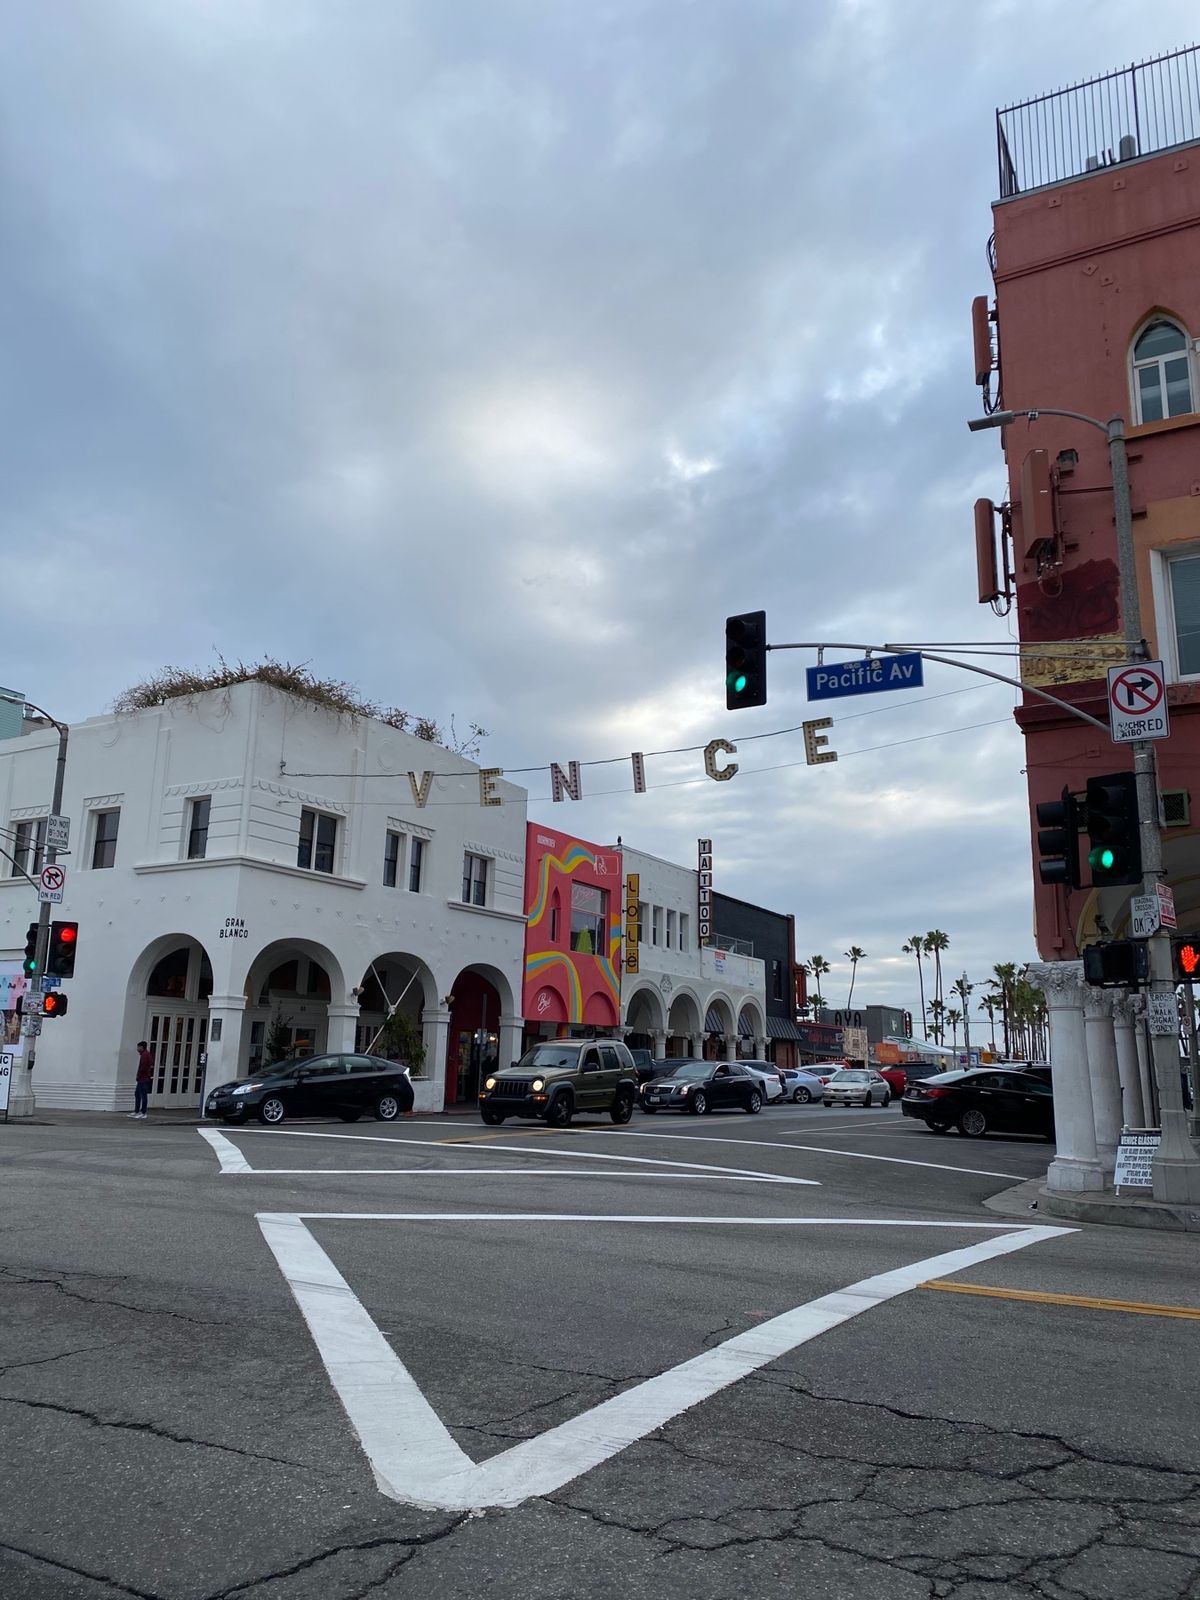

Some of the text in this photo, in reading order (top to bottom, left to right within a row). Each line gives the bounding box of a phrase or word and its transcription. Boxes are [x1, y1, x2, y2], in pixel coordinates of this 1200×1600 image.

[816, 663, 913, 690] Pacific Av
[1139, 718, 1163, 732] RED
[407, 716, 839, 809] VENICE
[49, 818, 69, 829] DO NOT
[700, 841, 709, 935] TATTOO
[40, 890, 61, 900] ON RED
[225, 917, 245, 928] GRAN
[1133, 917, 1145, 933] OK
[219, 928, 249, 939] BLANCO
[1154, 1008, 1173, 1016] WALK
[834, 1010, 861, 1029] AYA
[1151, 1016, 1176, 1025] SIGNAL
